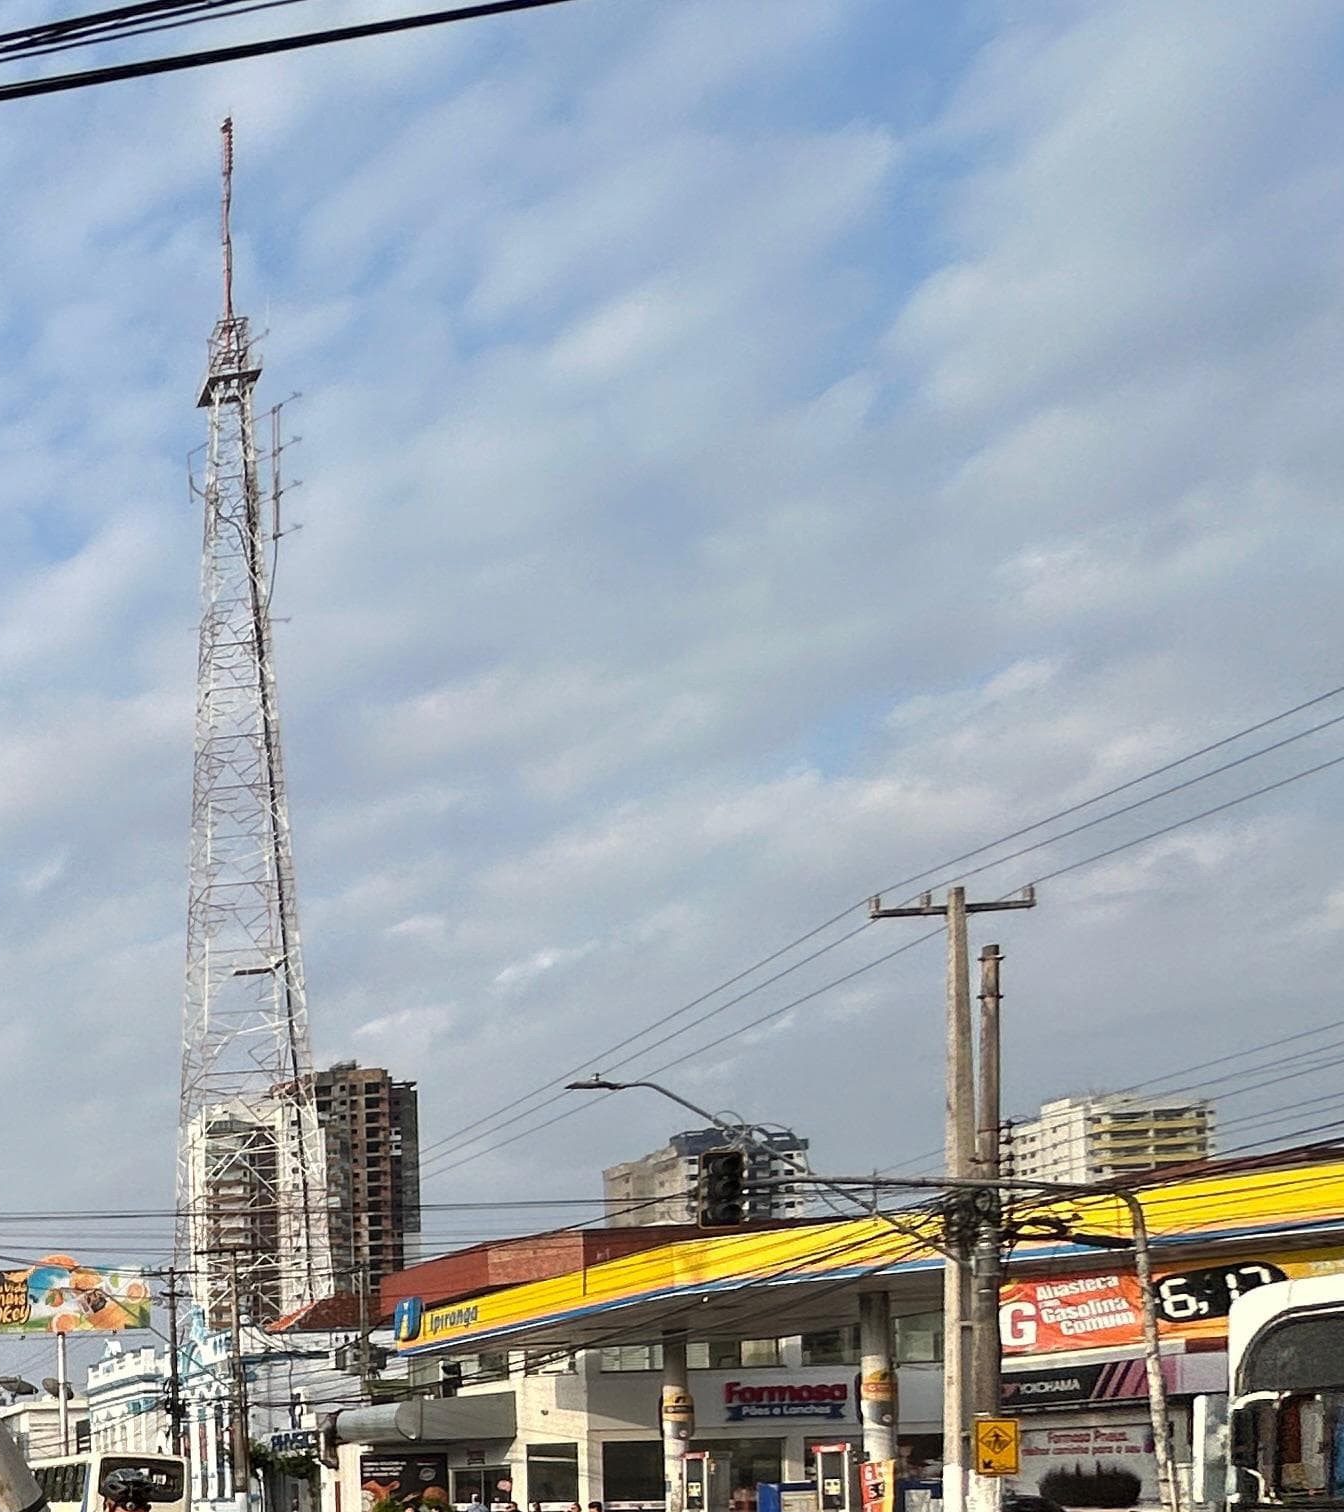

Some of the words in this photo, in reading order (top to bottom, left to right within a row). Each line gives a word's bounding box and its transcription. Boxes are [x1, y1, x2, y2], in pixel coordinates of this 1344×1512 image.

[1036, 1276, 1120, 1301] Abasteca
[1041, 1297, 1129, 1324] Gasolina
[1060, 1312, 1135, 1336] Comum
[724, 1381, 848, 1404] Formosa
[1019, 1379, 1081, 1395] YOKOHAMA
